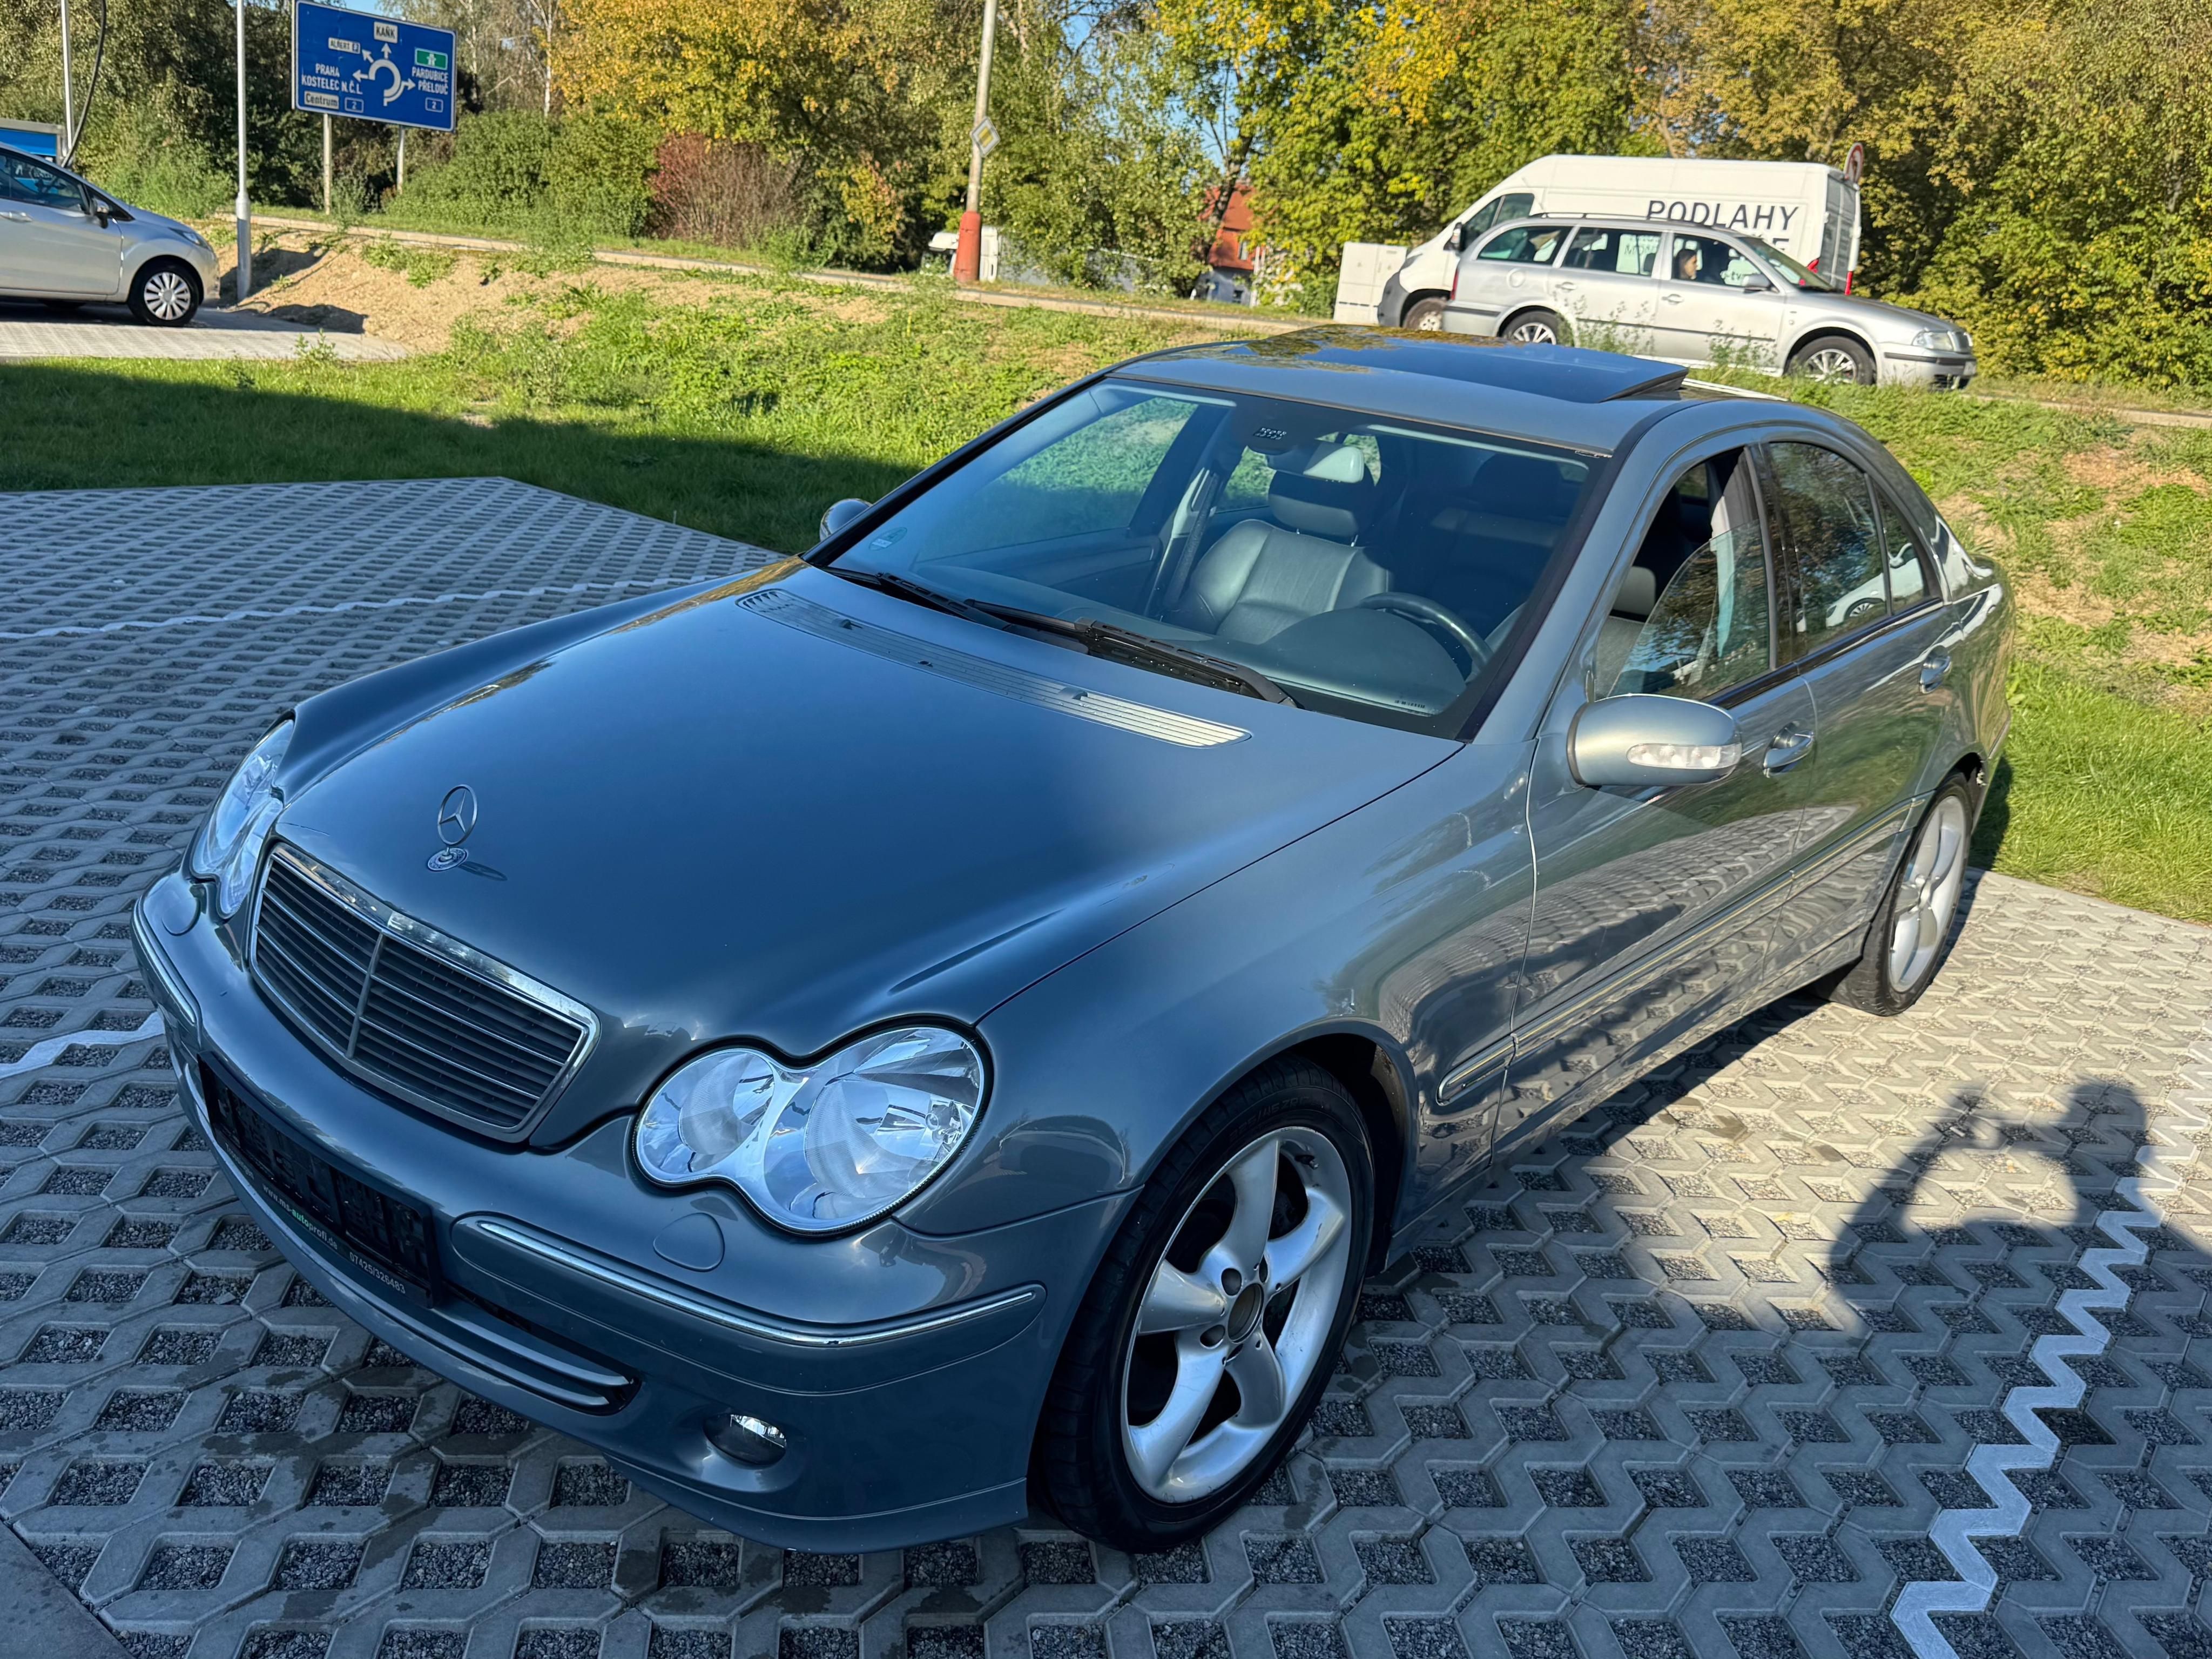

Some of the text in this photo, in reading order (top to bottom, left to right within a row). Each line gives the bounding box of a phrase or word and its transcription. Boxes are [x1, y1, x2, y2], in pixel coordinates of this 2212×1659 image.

[315, 63, 340, 77] PRAHA
[412, 66, 448, 83] PARDUBICE
[301, 75, 339, 91] KOSTELEC
[418, 79, 448, 95] PŘELOUČ
[306, 92, 338, 107] Centrum
[352, 101, 357, 109] 2
[431, 101, 436, 109] 2
[1647, 200, 1799, 230] PODLAHY
